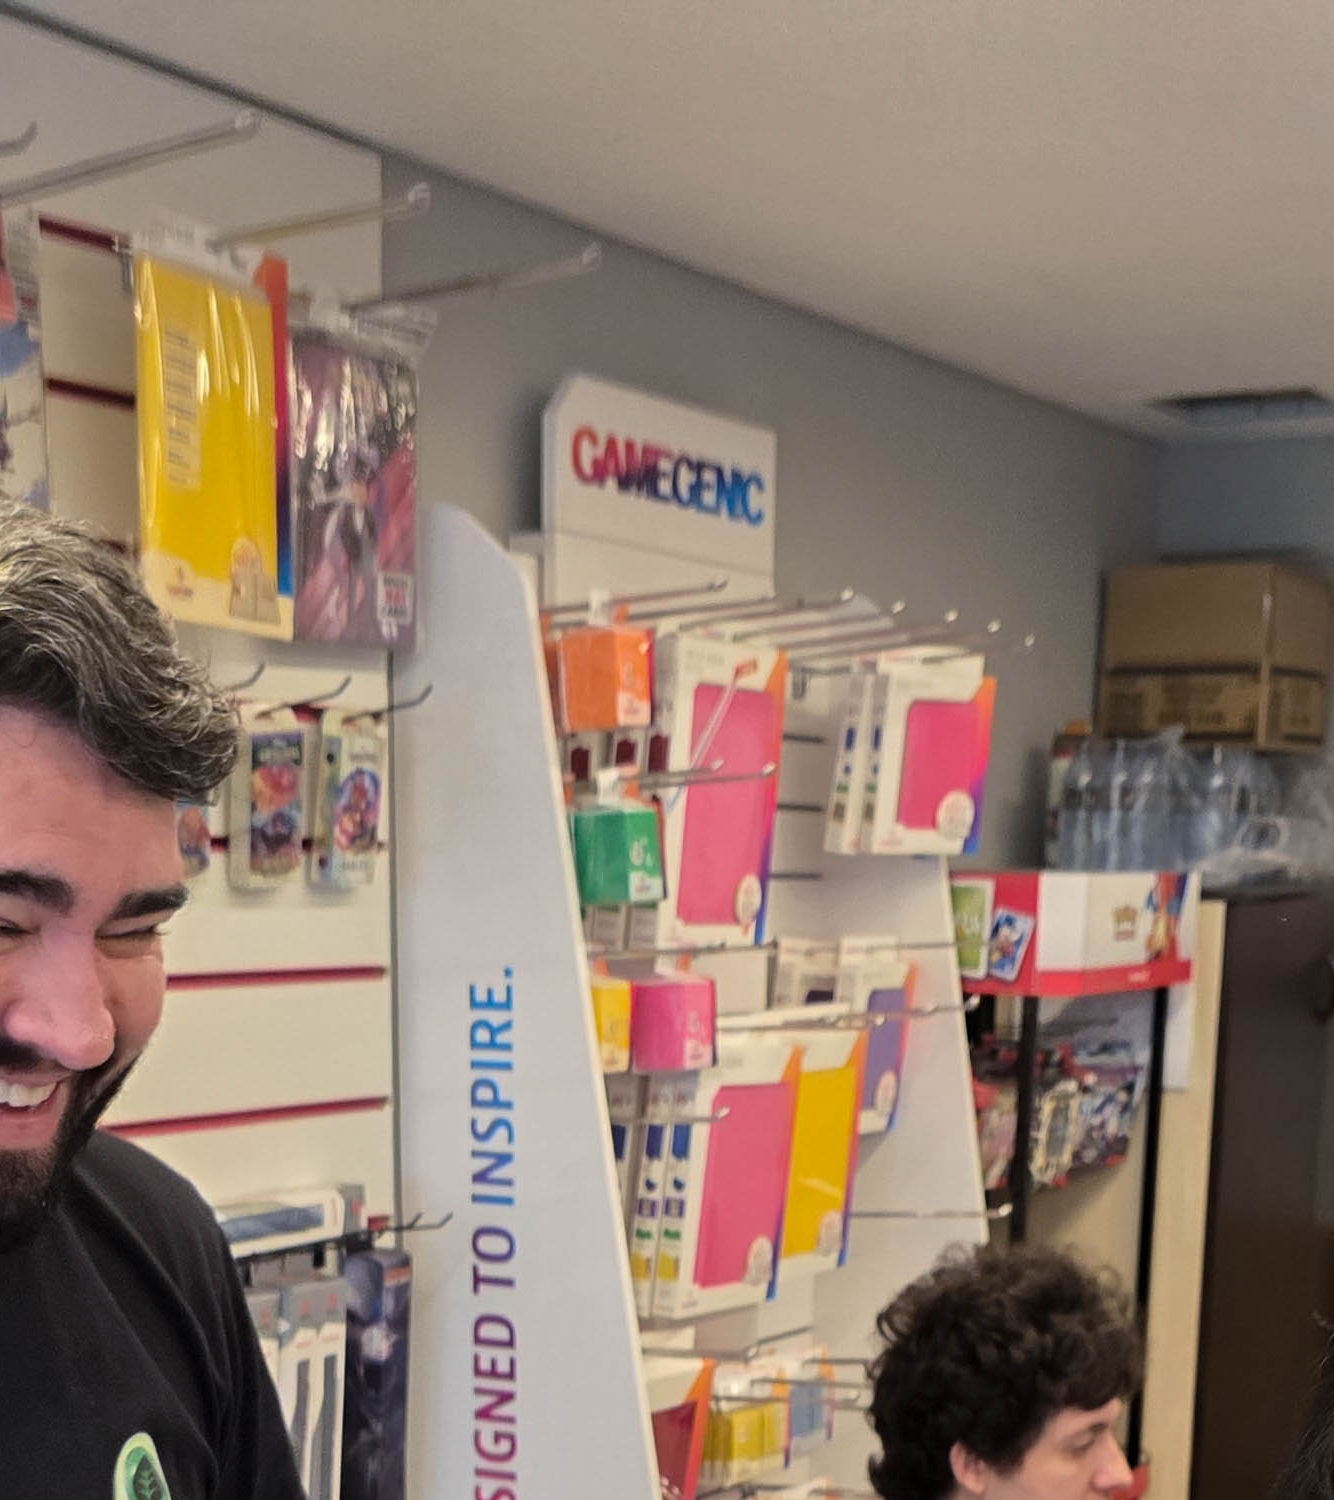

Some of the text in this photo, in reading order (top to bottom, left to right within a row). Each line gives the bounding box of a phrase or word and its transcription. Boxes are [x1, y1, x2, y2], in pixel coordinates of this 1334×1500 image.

[572, 425, 765, 527] GAMEGENIC
[468, 966, 515, 1208] INSPIRE.
[469, 1225, 517, 1294] TO
